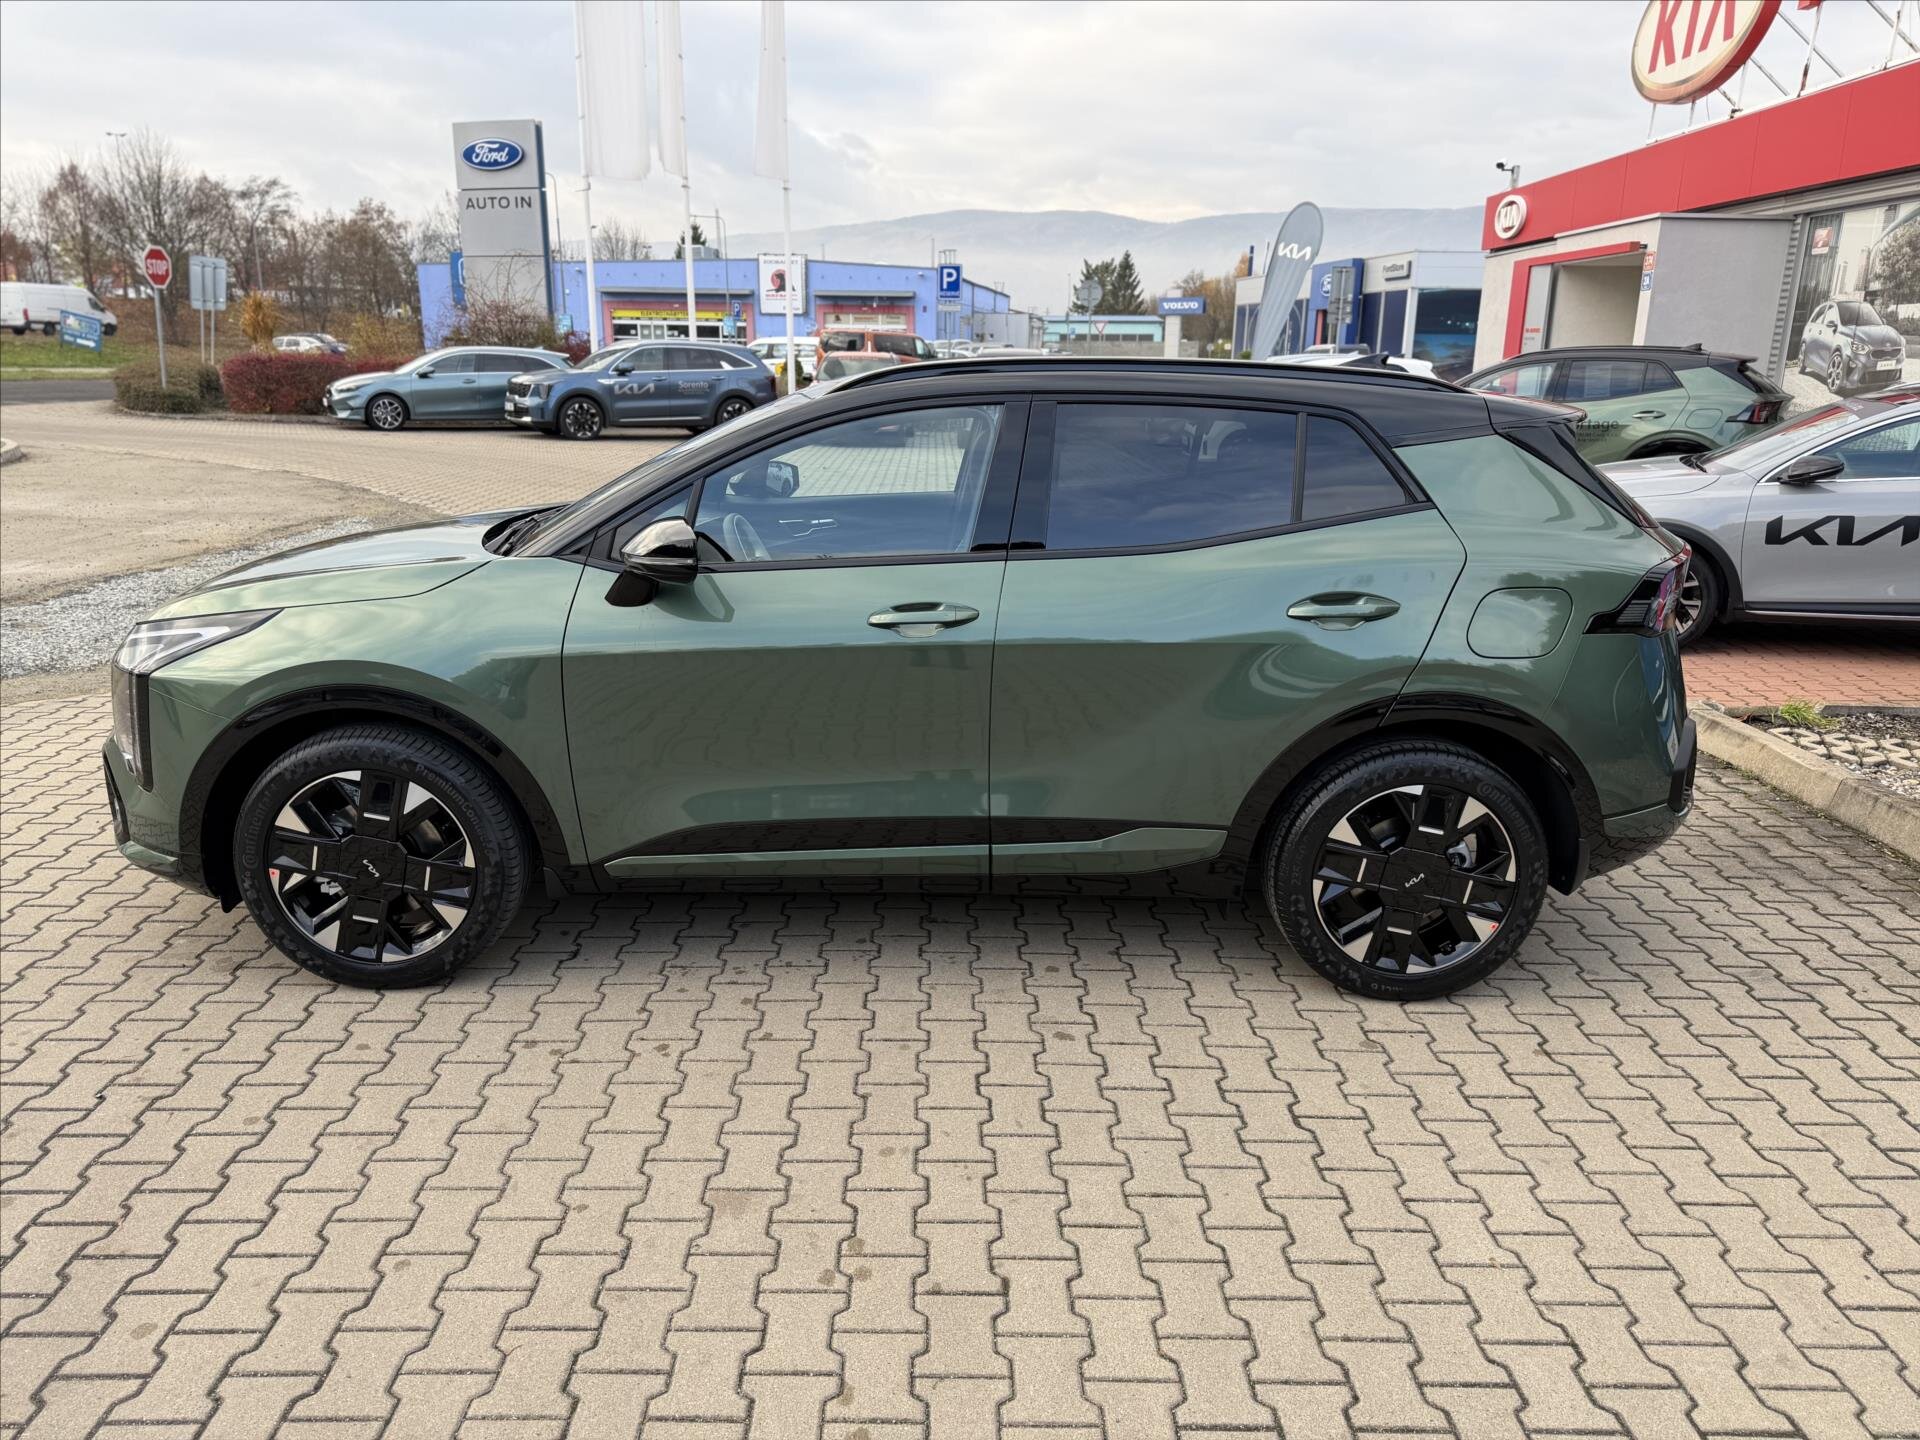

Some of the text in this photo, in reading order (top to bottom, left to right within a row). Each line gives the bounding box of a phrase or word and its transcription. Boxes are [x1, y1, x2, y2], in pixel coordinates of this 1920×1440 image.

[1648, 0, 1735, 74] KIA
[472, 143, 508, 163] Ford
[466, 196, 532, 210] AUTO IN
[1278, 242, 1312, 261] KIA
[147, 259, 167, 275] STOP
[943, 269, 957, 289] P
[1163, 301, 1199, 310] VOLVO
[614, 383, 655, 394] KIA
[678, 381, 709, 389] Sorento
[1576, 419, 1619, 432] rtage
[1765, 515, 1920, 547] KIA
[1476, 780, 1536, 842] Continental
[242, 790, 276, 869] Continental
[363, 859, 380, 877] KIA
[1405, 872, 1424, 887] KIA
